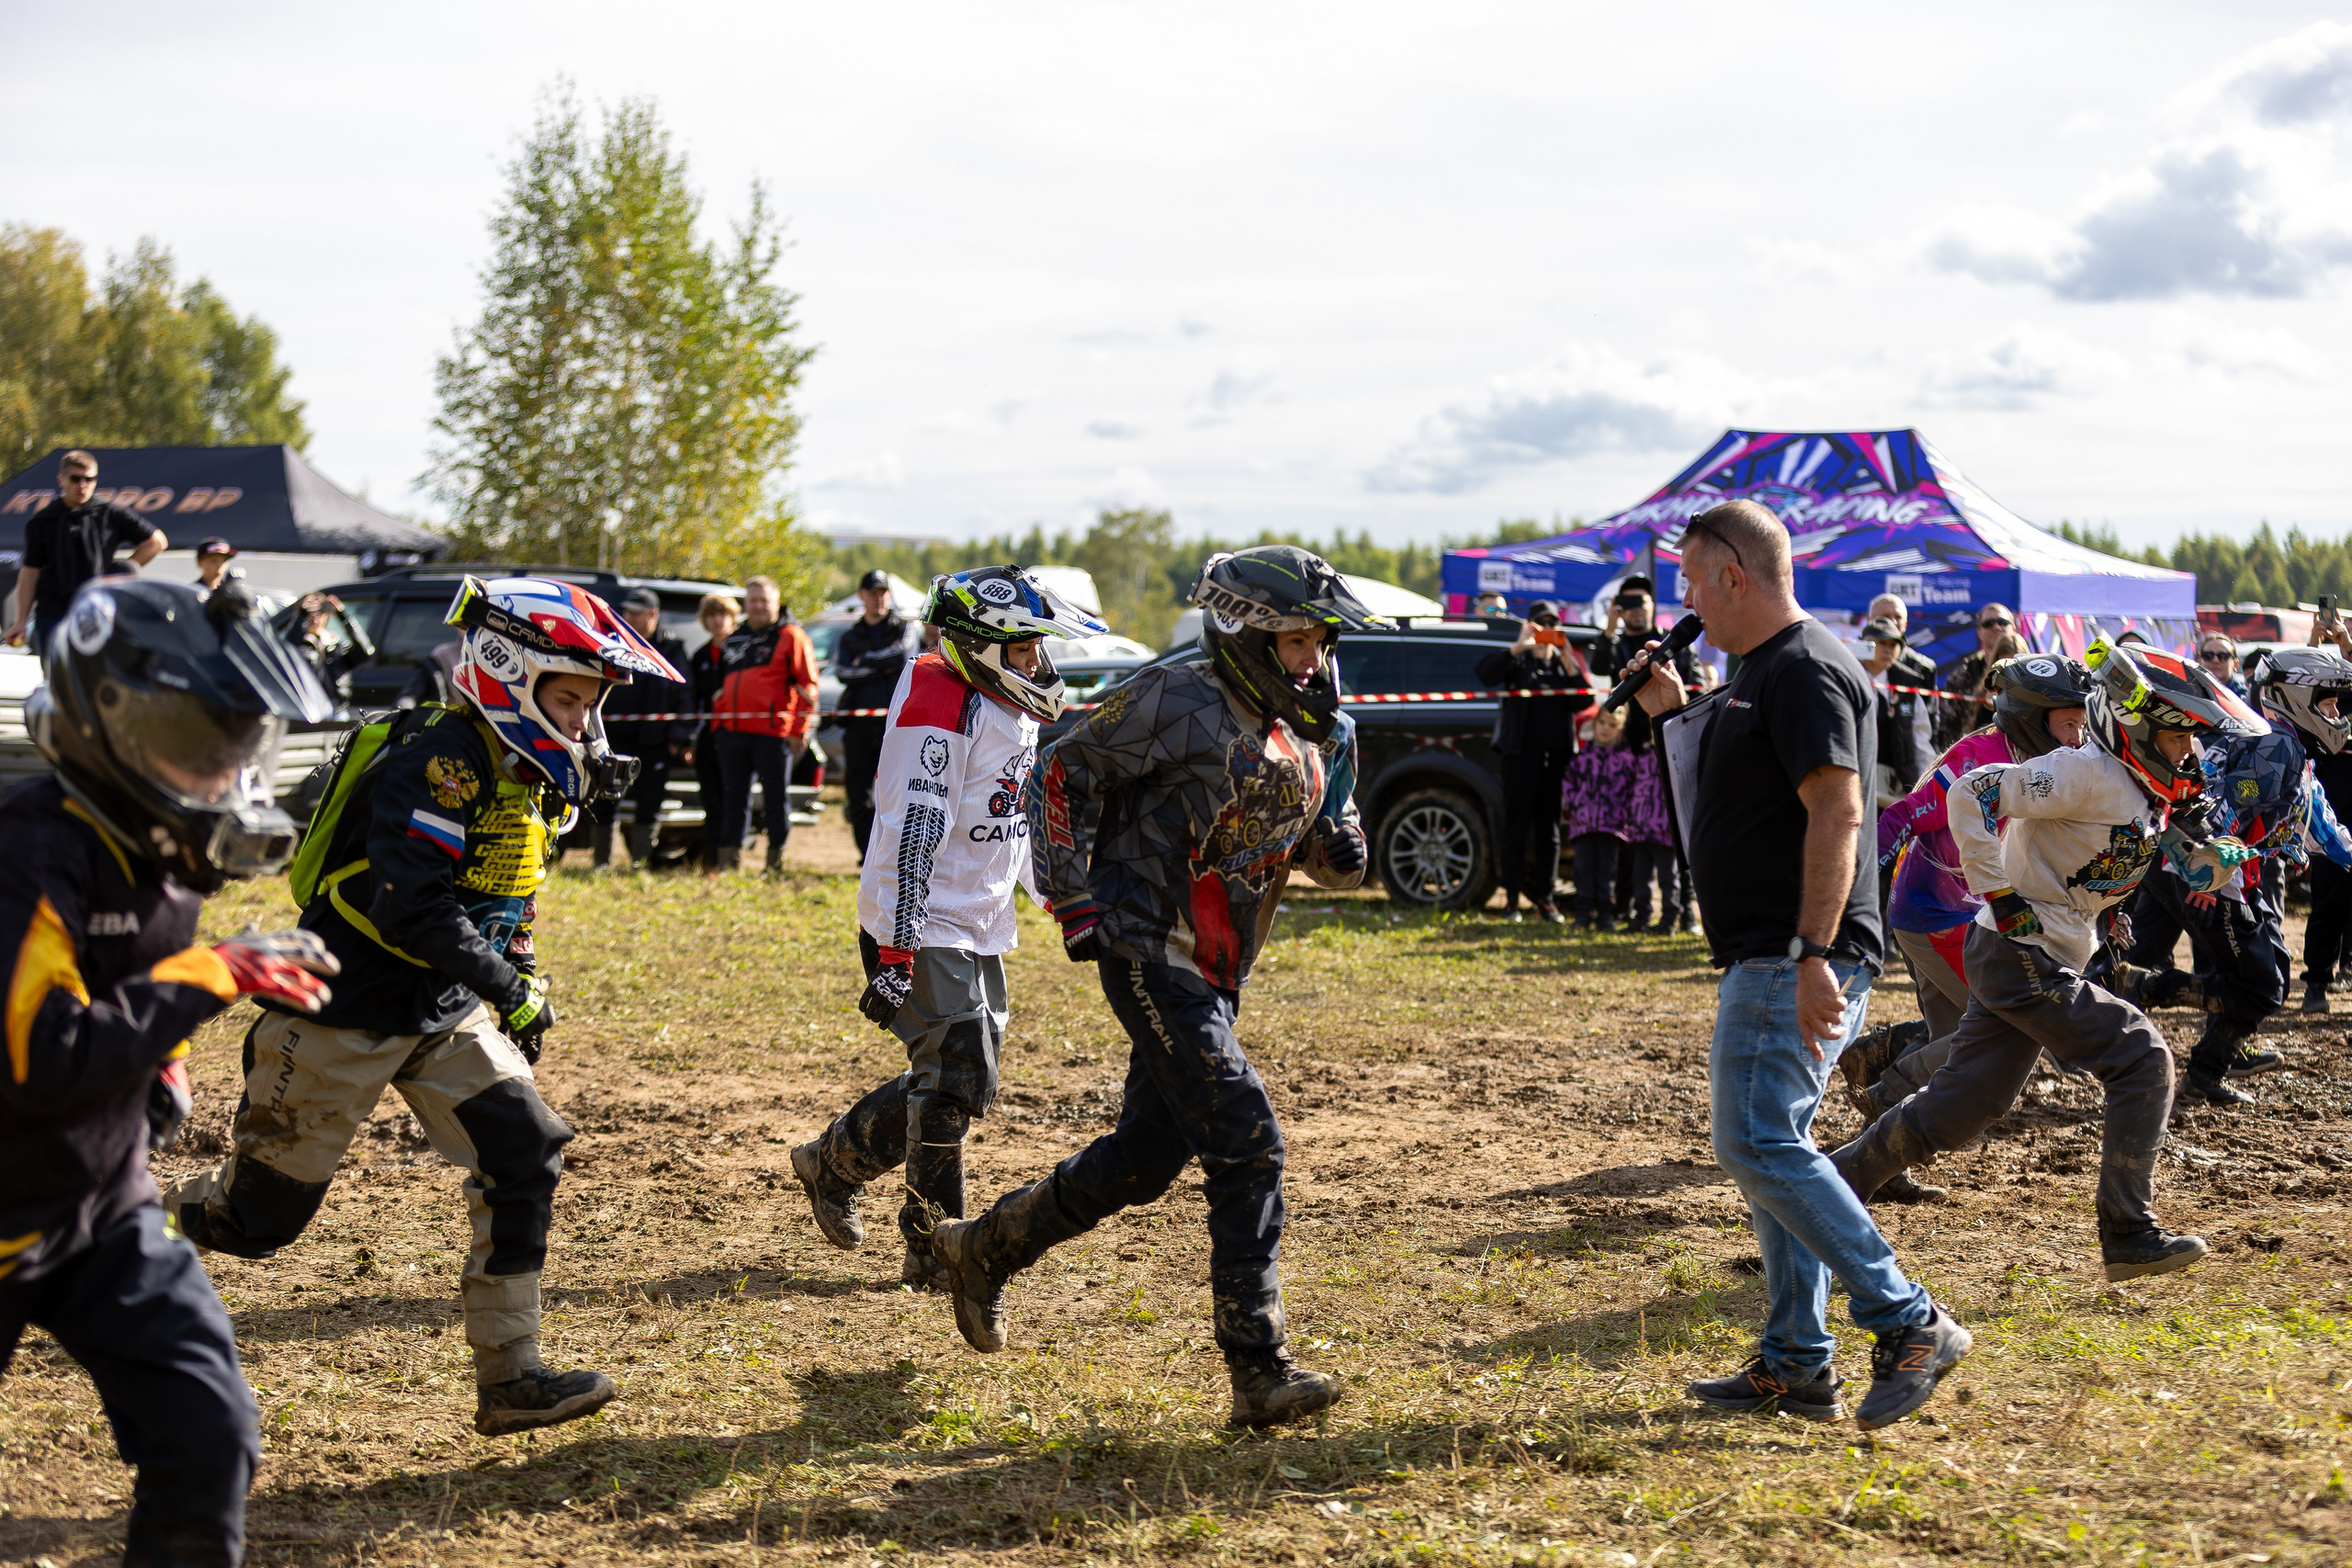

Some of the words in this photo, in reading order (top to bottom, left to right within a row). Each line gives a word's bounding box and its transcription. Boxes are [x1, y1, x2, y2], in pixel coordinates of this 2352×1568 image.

[981, 584, 1012, 601] 888
[1922, 588, 1972, 604] Team
[481, 638, 510, 669] 499
[2030, 662, 2051, 675] 414
[1045, 753, 1076, 852] TEAM
[969, 819, 1029, 843] САМО
[871, 975, 904, 1009] Race
